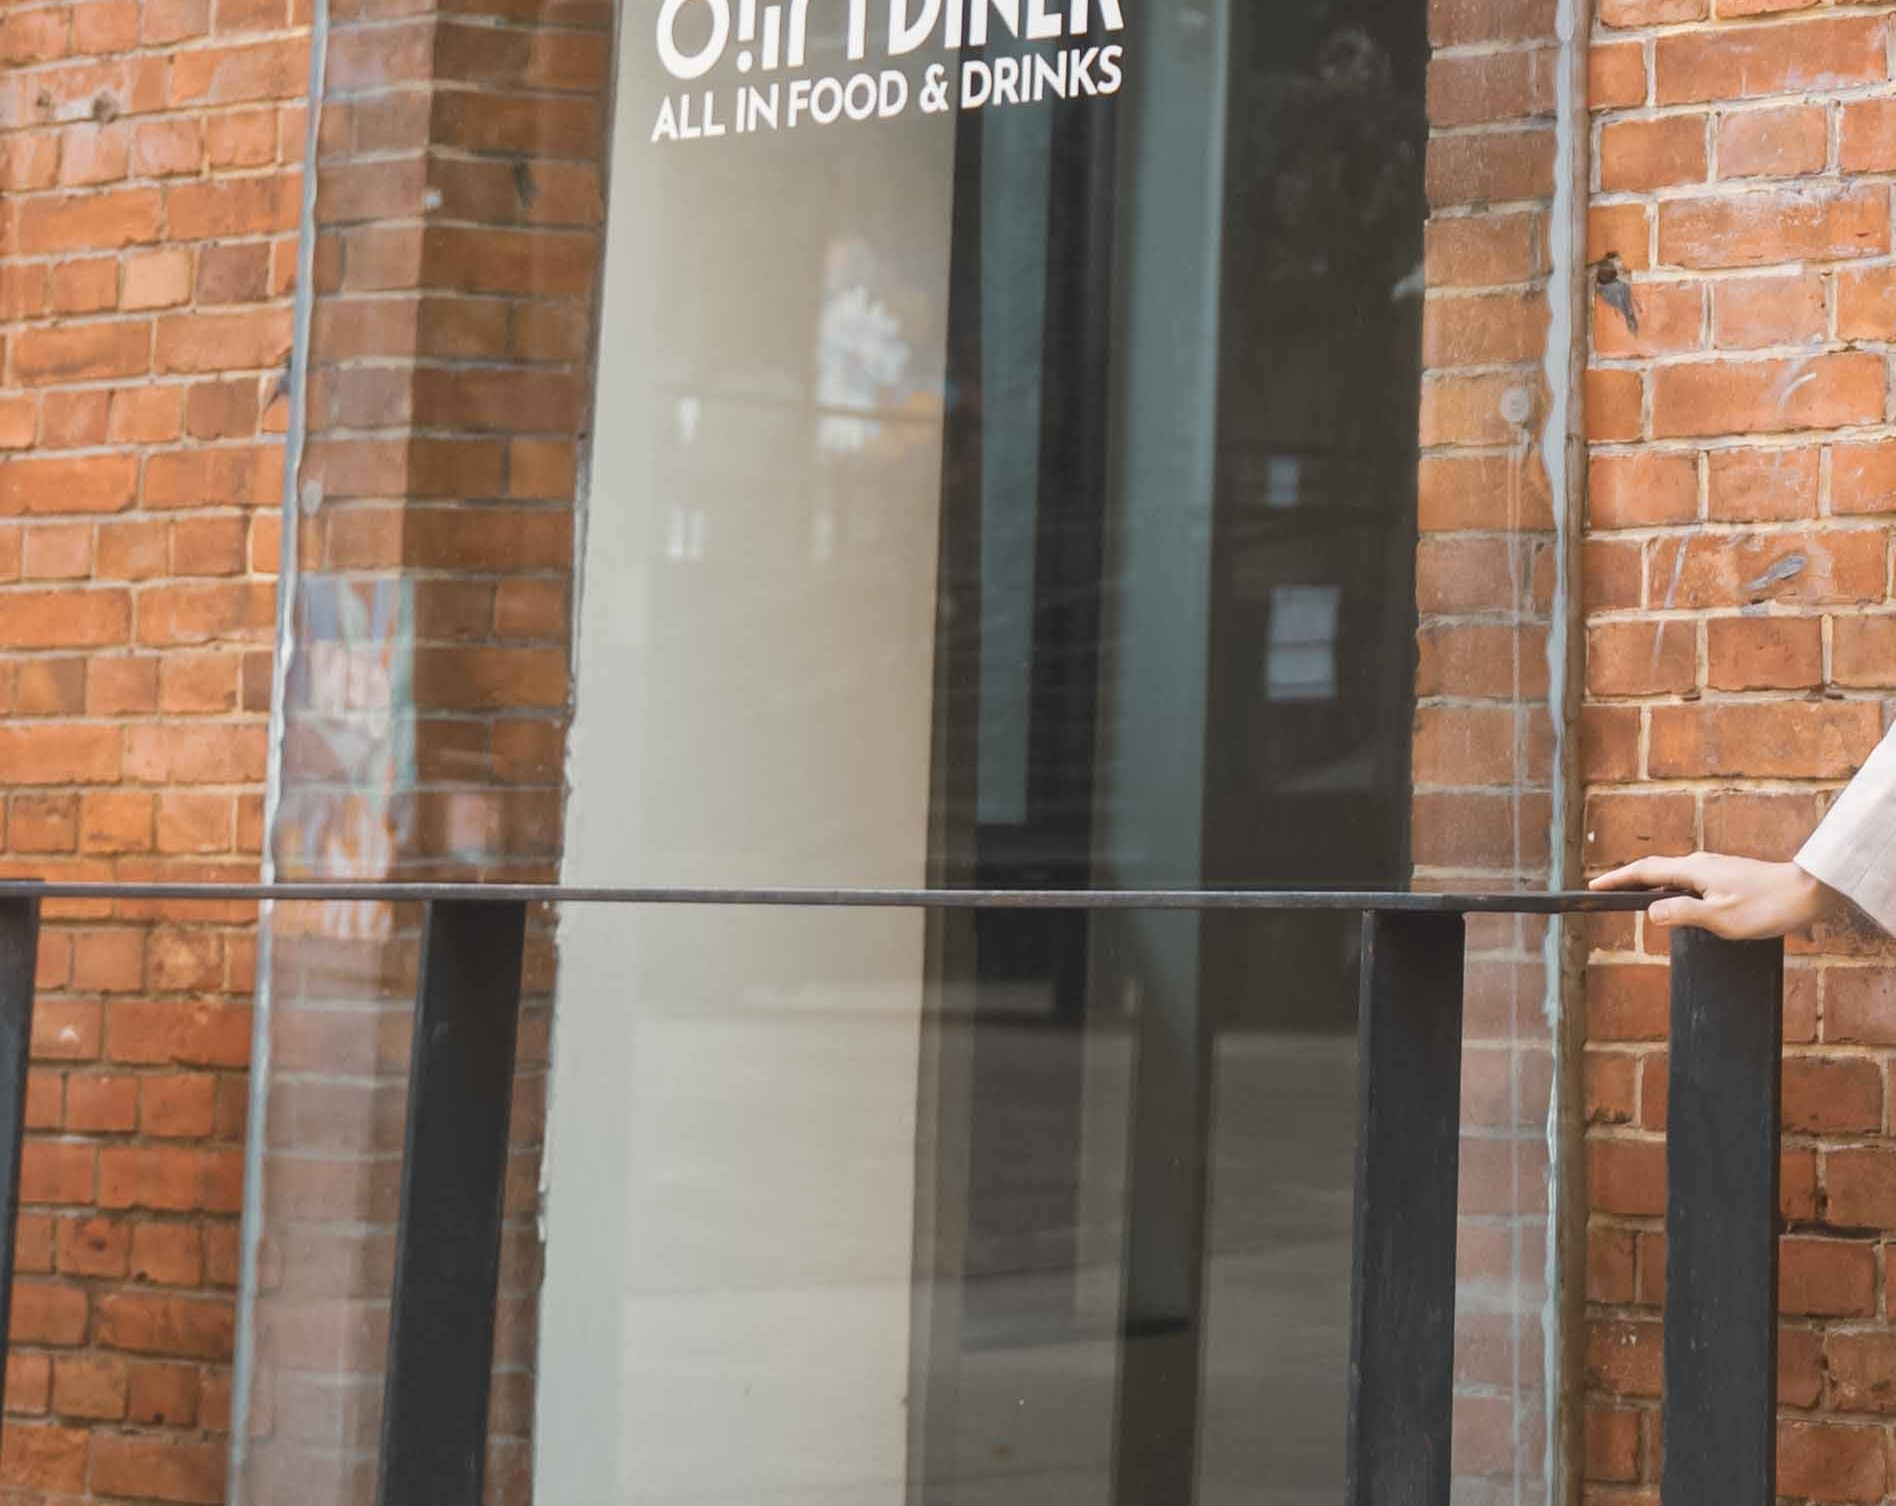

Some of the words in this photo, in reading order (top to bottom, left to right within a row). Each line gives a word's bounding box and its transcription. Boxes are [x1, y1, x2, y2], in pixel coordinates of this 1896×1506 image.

[651, 90, 725, 142] ALL
[737, 83, 778, 133] IN
[787, 70, 908, 128] FOOD
[920, 63, 950, 113] &
[961, 45, 1123, 109] DRINKS
